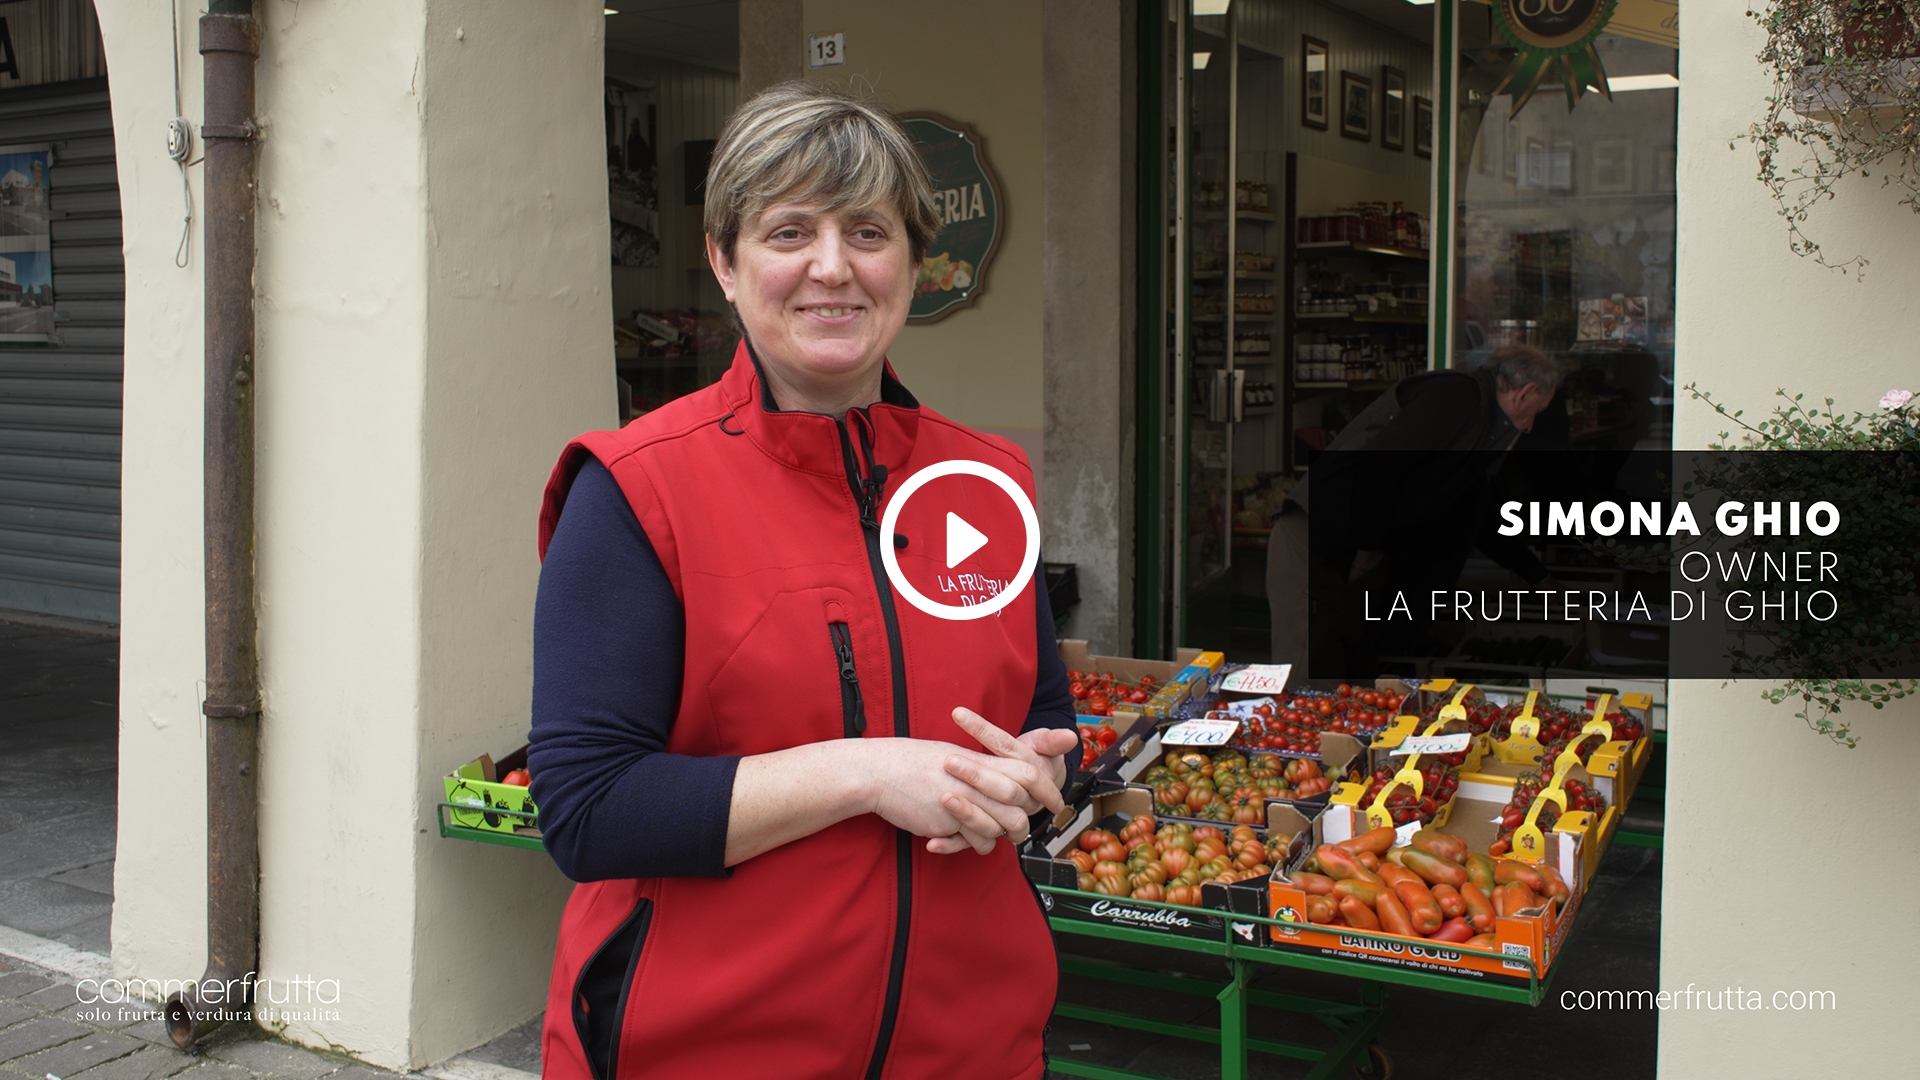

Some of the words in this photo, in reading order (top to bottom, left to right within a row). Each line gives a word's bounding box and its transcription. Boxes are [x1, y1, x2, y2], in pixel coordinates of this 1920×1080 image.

[817, 41, 836, 59] 13
[938, 575, 958, 592] LA
[1090, 900, 1191, 928] Carrubba
[1338, 950, 1357, 958] codice
[1358, 952, 1368, 960] QR
[1368, 954, 1400, 964] conoscerai
[1457, 968, 1484, 977] coltivato
